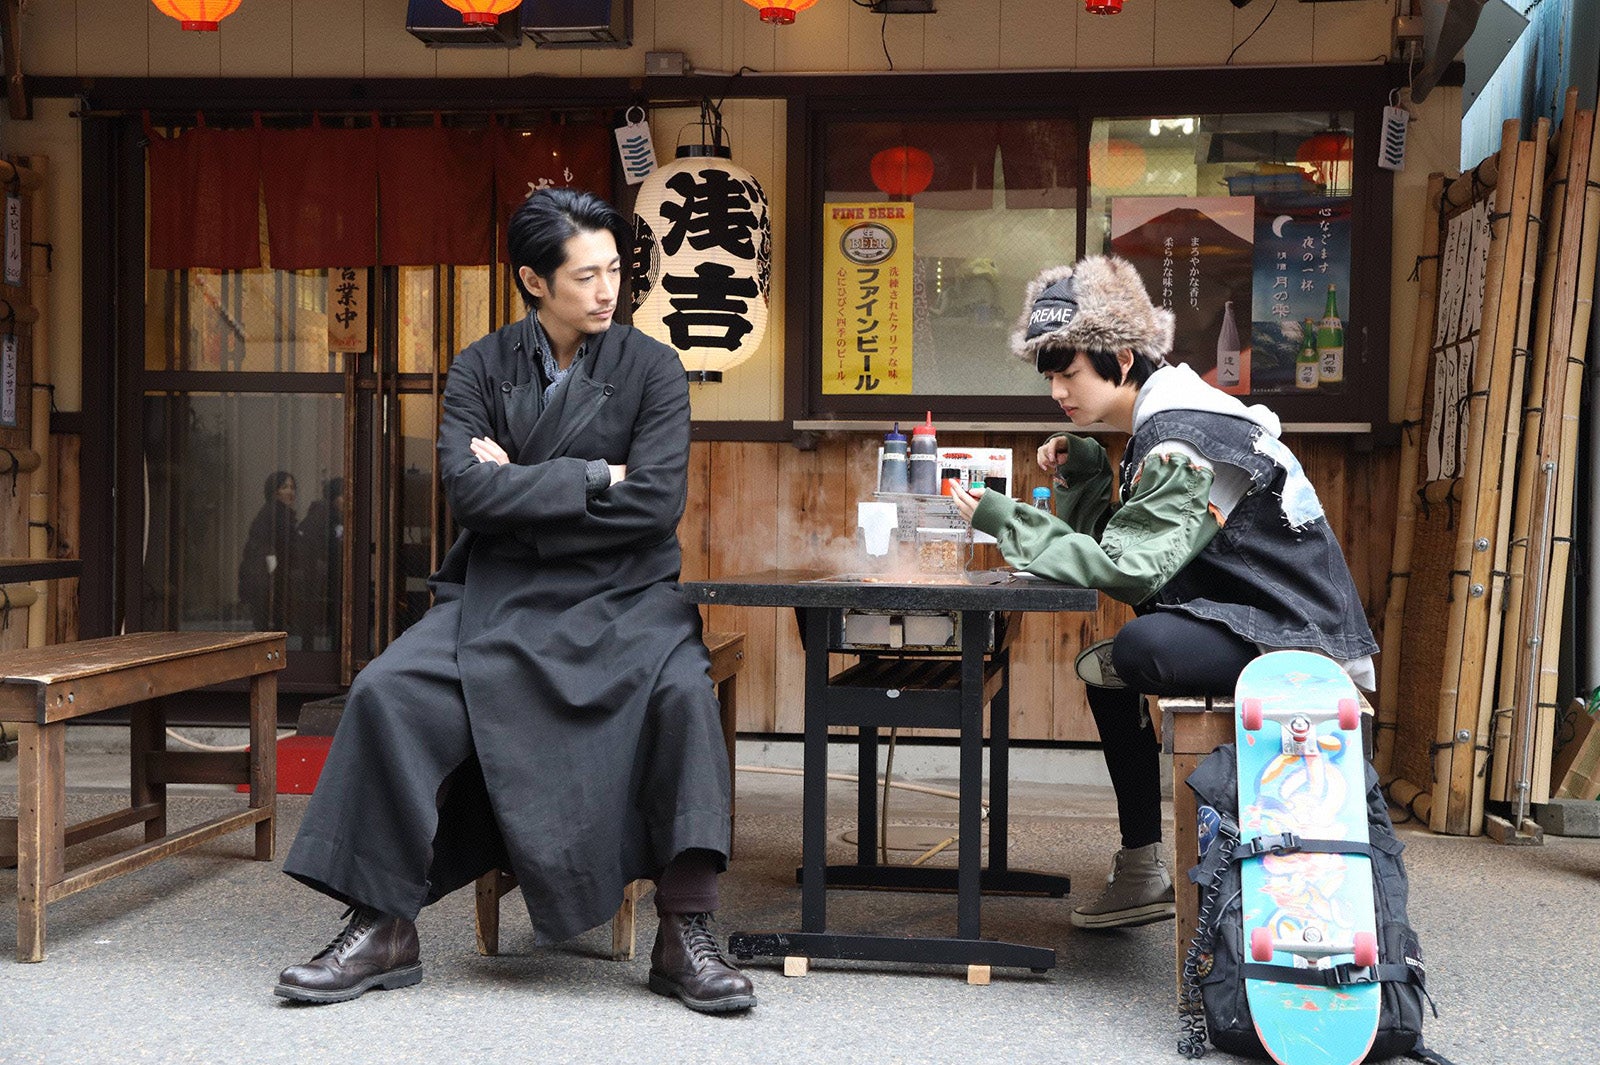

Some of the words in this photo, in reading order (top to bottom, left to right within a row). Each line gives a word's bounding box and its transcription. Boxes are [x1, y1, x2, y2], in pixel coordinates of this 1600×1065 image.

[9, 203, 19, 260] 生ビール
[832, 207, 864, 219] FINE
[868, 207, 905, 219] BEER
[1319, 208, 1332, 273] 心なごます
[660, 169, 759, 352] 浅吉
[849, 239, 889, 250] BEER
[1301, 236, 1315, 292] 夜の一杯
[1189, 236, 1200, 311] まろやかな香り、
[1272, 276, 1290, 318] 月の雫
[855, 268, 880, 391] ファインビール
